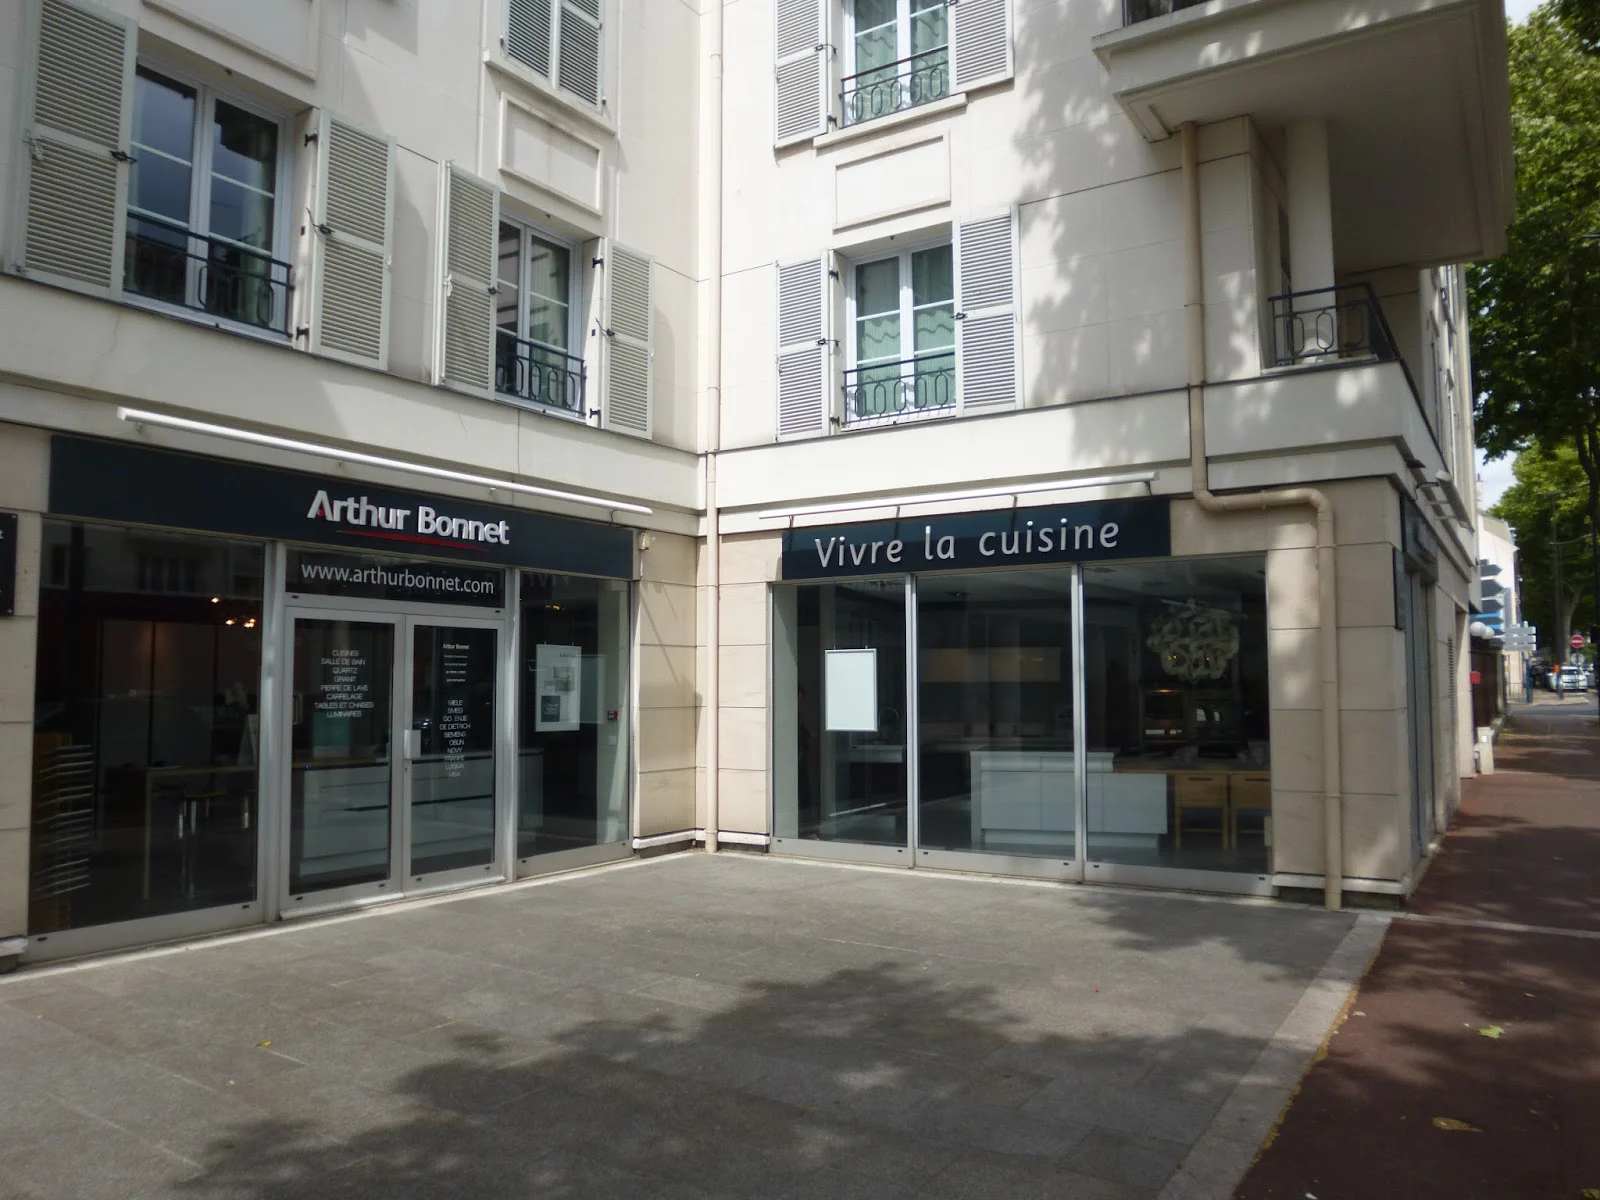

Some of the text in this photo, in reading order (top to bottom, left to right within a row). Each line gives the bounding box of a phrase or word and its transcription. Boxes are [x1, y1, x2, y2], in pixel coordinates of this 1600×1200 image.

[307, 489, 510, 545] Arthur Bonnet
[814, 517, 1120, 568] Vivre la cuisine
[301, 563, 495, 595] www.arthurbonnet.com
[332, 649, 360, 657] CUISINES
[341, 658, 350, 666] DE
[351, 658, 366, 666] BAIN
[333, 675, 357, 683] GRANIT
[320, 684, 369, 692] PIERRE DE LAVE
[326, 693, 363, 701] CARRELAGE
[348, 701, 375, 709] CHAISES
[326, 710, 362, 718] LUMINAIRES
[439, 723, 448, 731] DE
